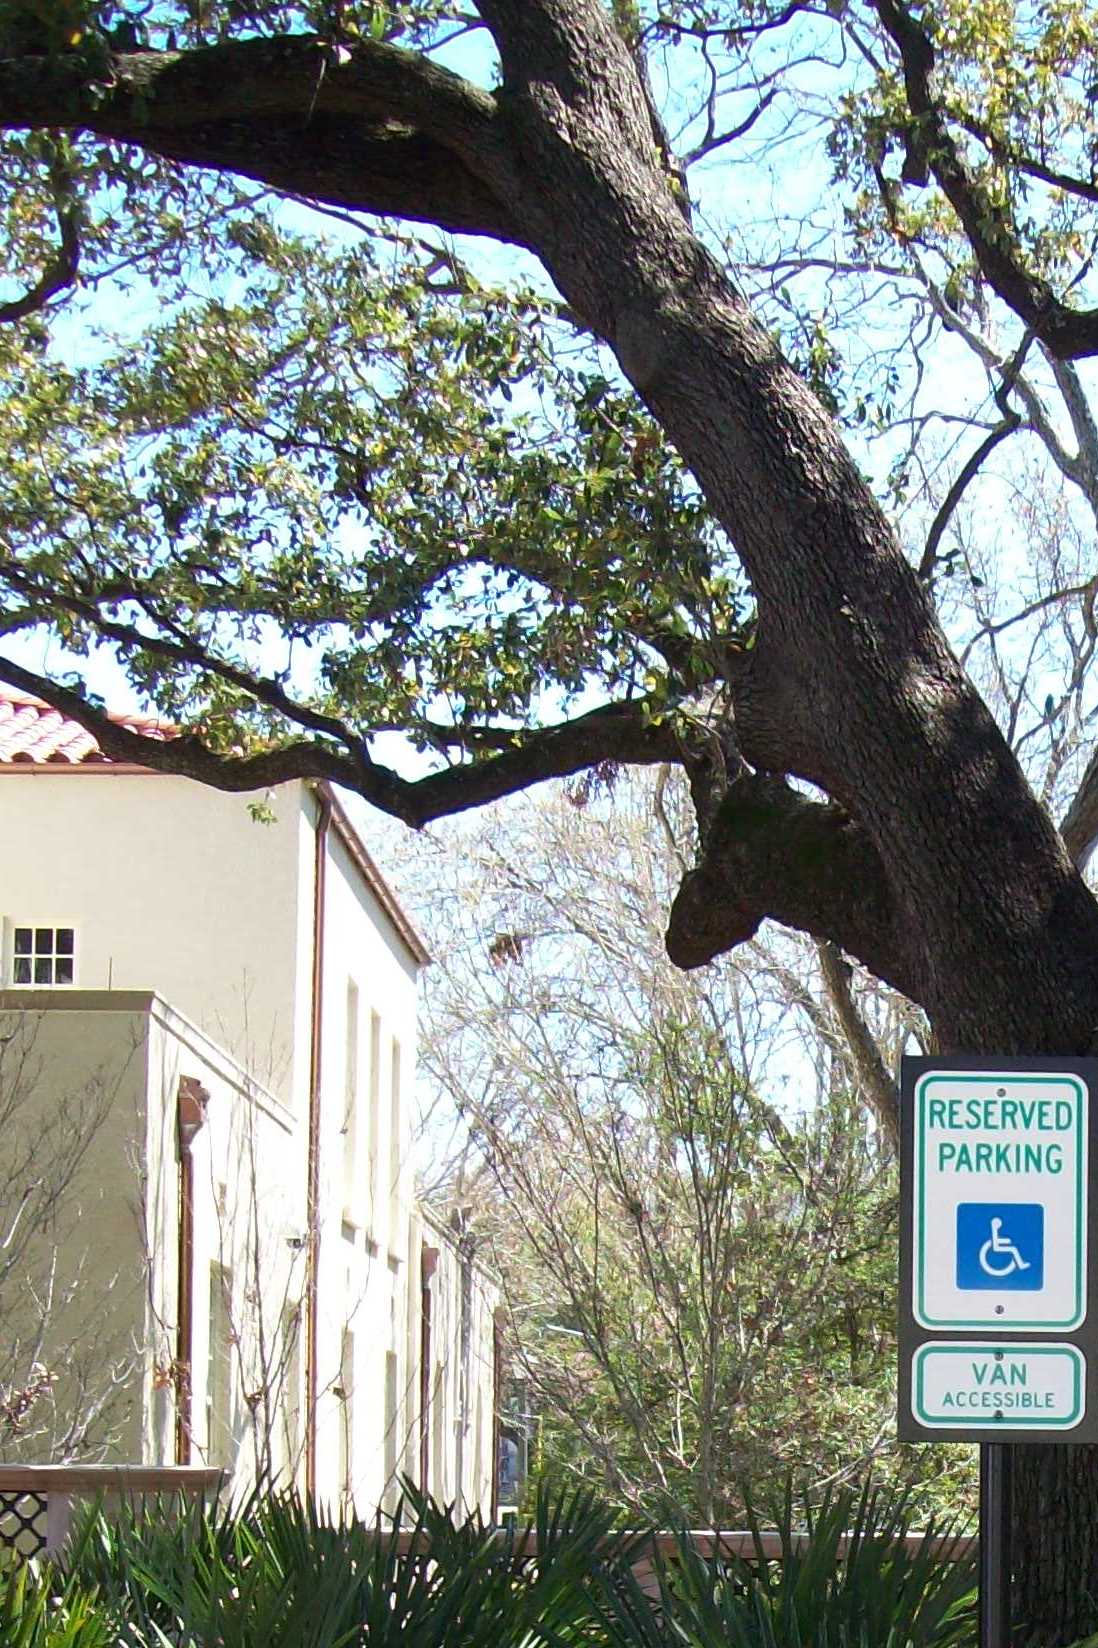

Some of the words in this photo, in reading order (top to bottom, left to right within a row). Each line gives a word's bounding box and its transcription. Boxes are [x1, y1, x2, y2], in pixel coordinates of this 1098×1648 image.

[929, 1099, 1073, 1131] RESERVED
[938, 1142, 1063, 1174] PARKING
[972, 1362, 1027, 1386] VAN
[942, 1391, 1055, 1409] ACCESSIBLE
